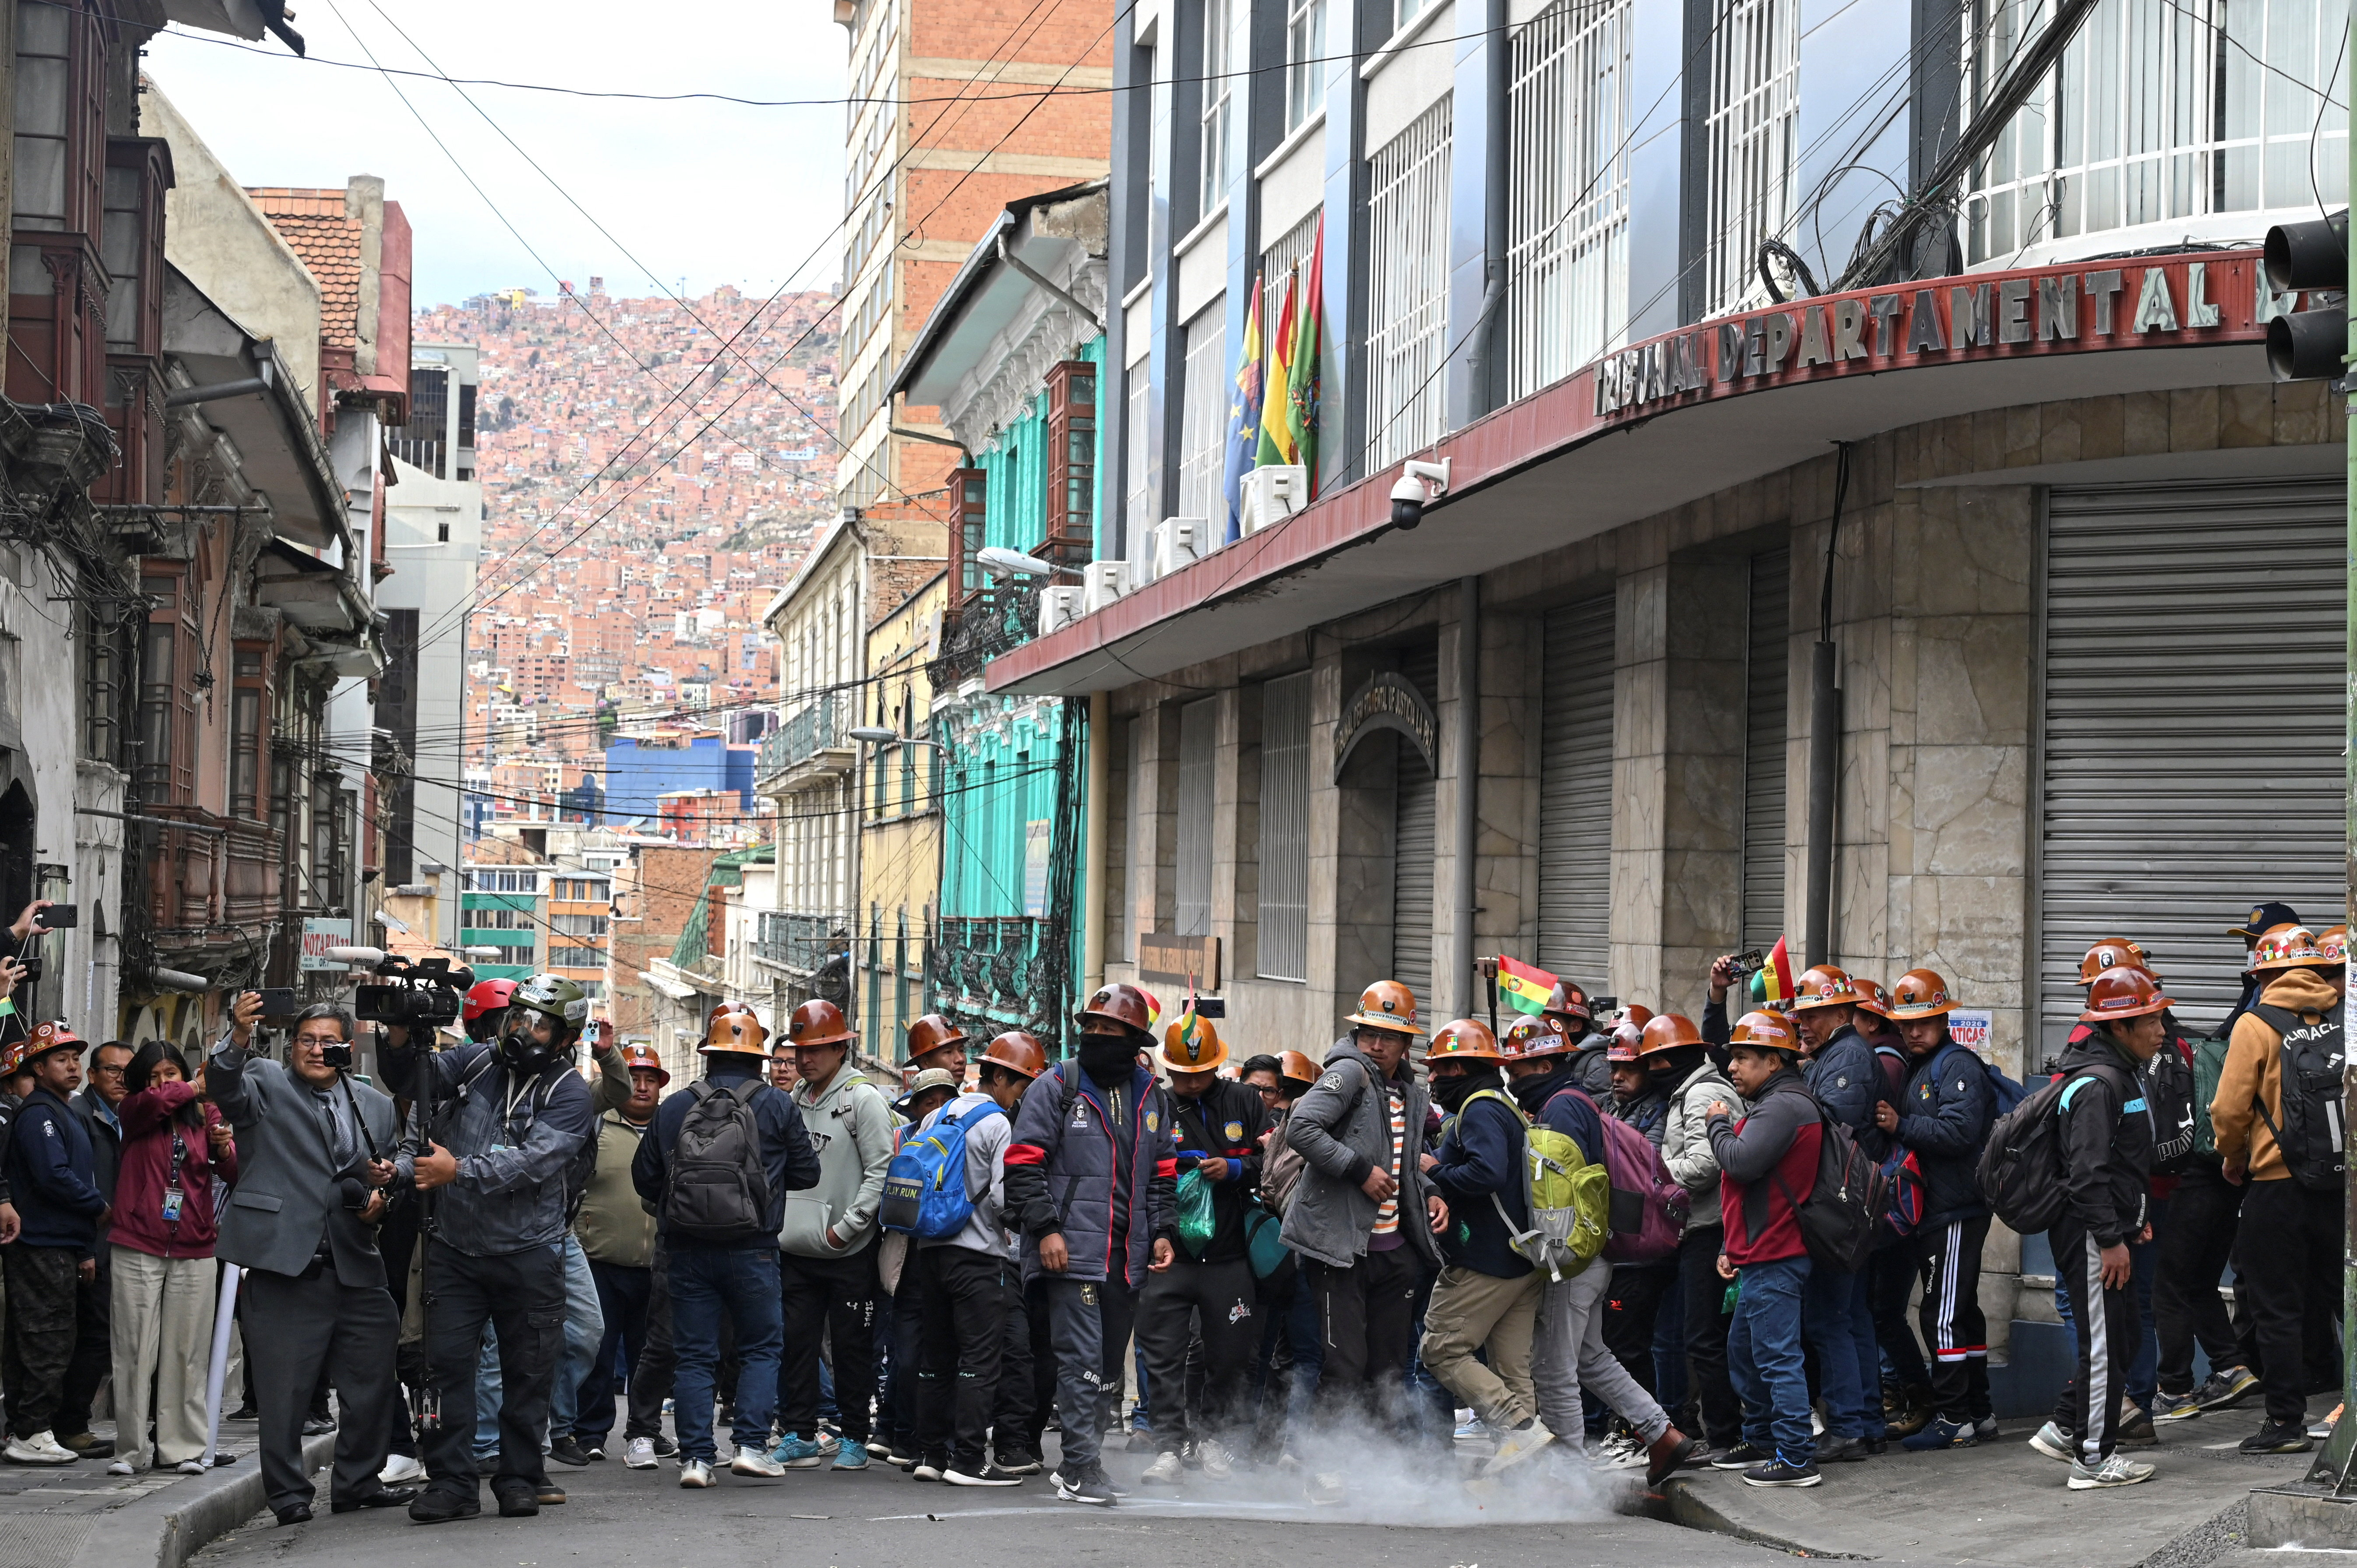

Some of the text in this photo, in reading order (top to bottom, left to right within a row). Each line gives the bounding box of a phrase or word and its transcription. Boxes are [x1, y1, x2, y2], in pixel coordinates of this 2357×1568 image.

[1594, 331, 1707, 416] TRIBUNAL
[1718, 262, 2220, 382] DEPARTAMENTAL
[518, 984, 554, 1001] REUTERS
[2104, 998, 2131, 1007] CARACOLES
[886, 1185, 917, 1198] PLAY RUN
[1926, 1266, 1936, 1293] adidas
